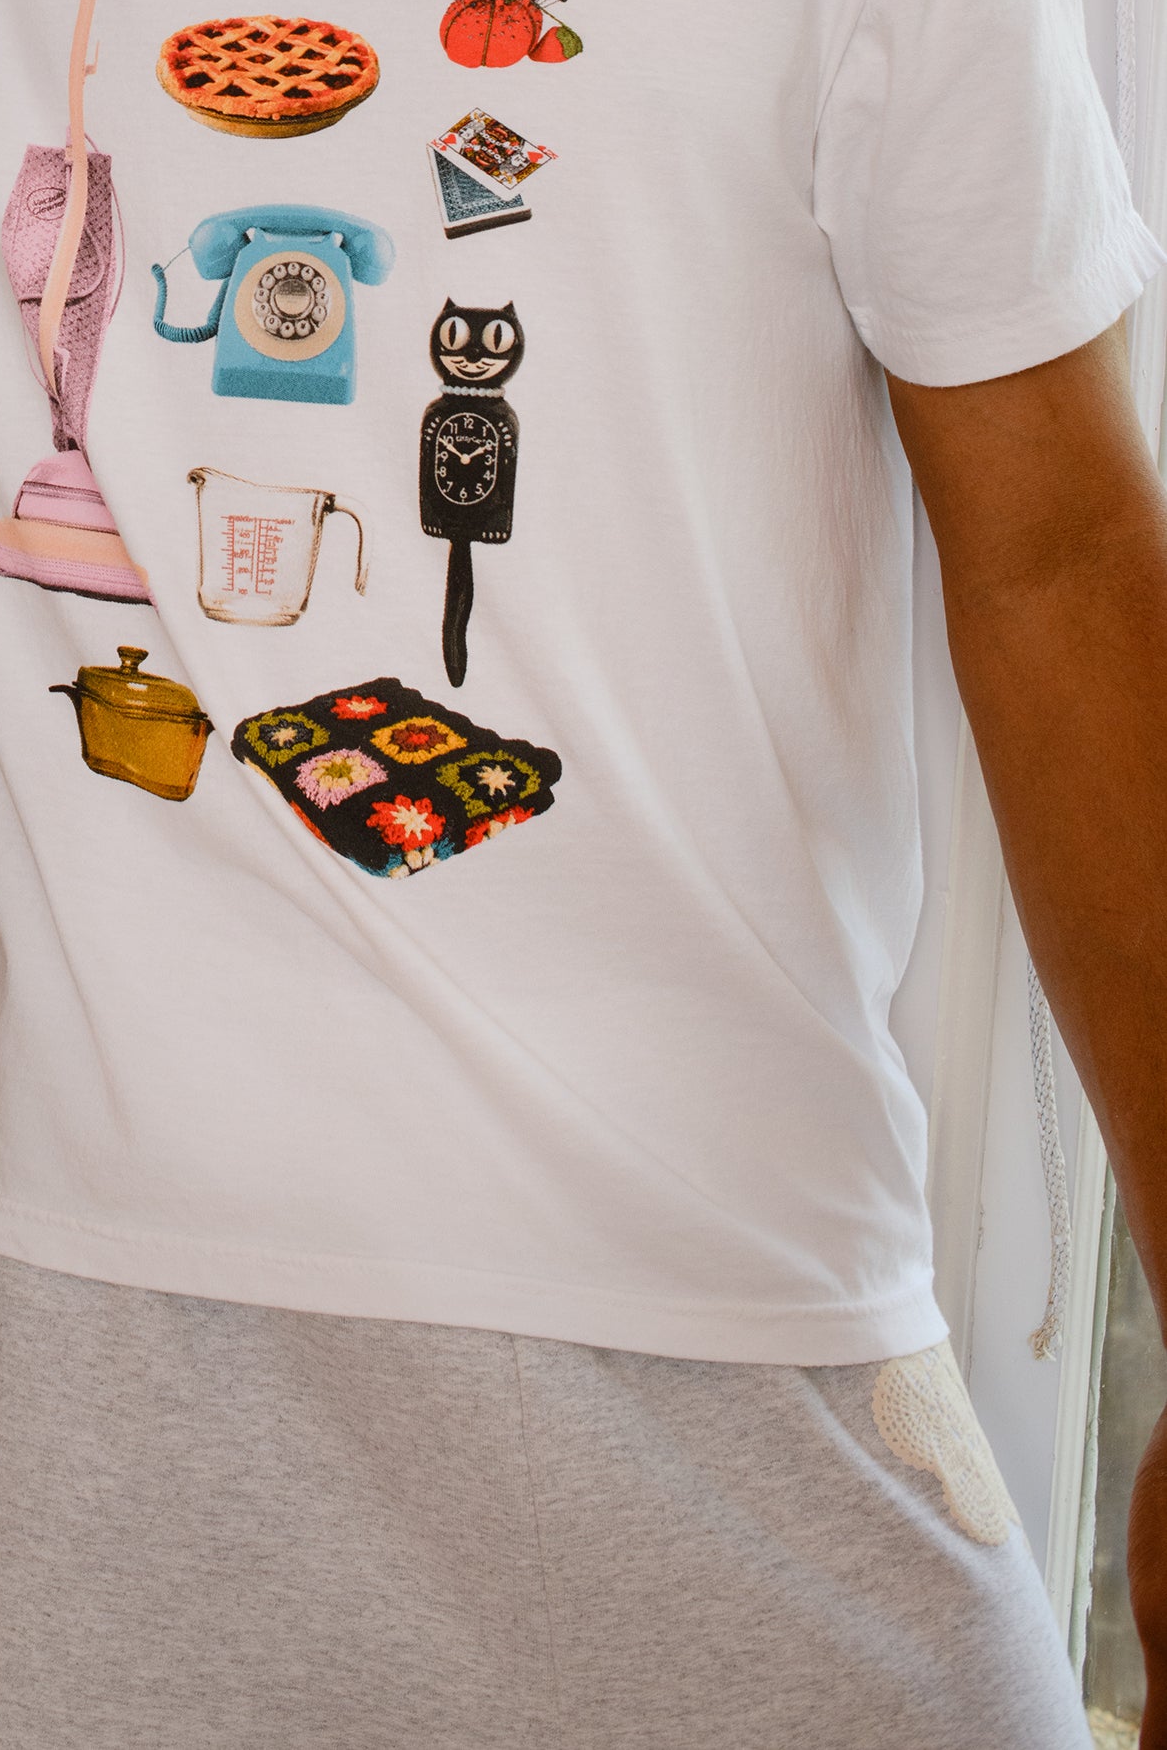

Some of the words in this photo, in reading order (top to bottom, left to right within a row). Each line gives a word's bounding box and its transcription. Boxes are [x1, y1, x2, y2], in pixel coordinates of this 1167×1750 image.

[449, 422, 458, 434] 11
[463, 417, 474, 429] 12
[482, 425, 487, 437] 1
[441, 451, 448, 462] 9
[485, 455, 492, 466] 3
[440, 466, 447, 477] 8
[483, 470, 490, 480] 4
[446, 481, 454, 492] 7
[475, 483, 483, 494] 5
[459, 487, 467, 499] 6
